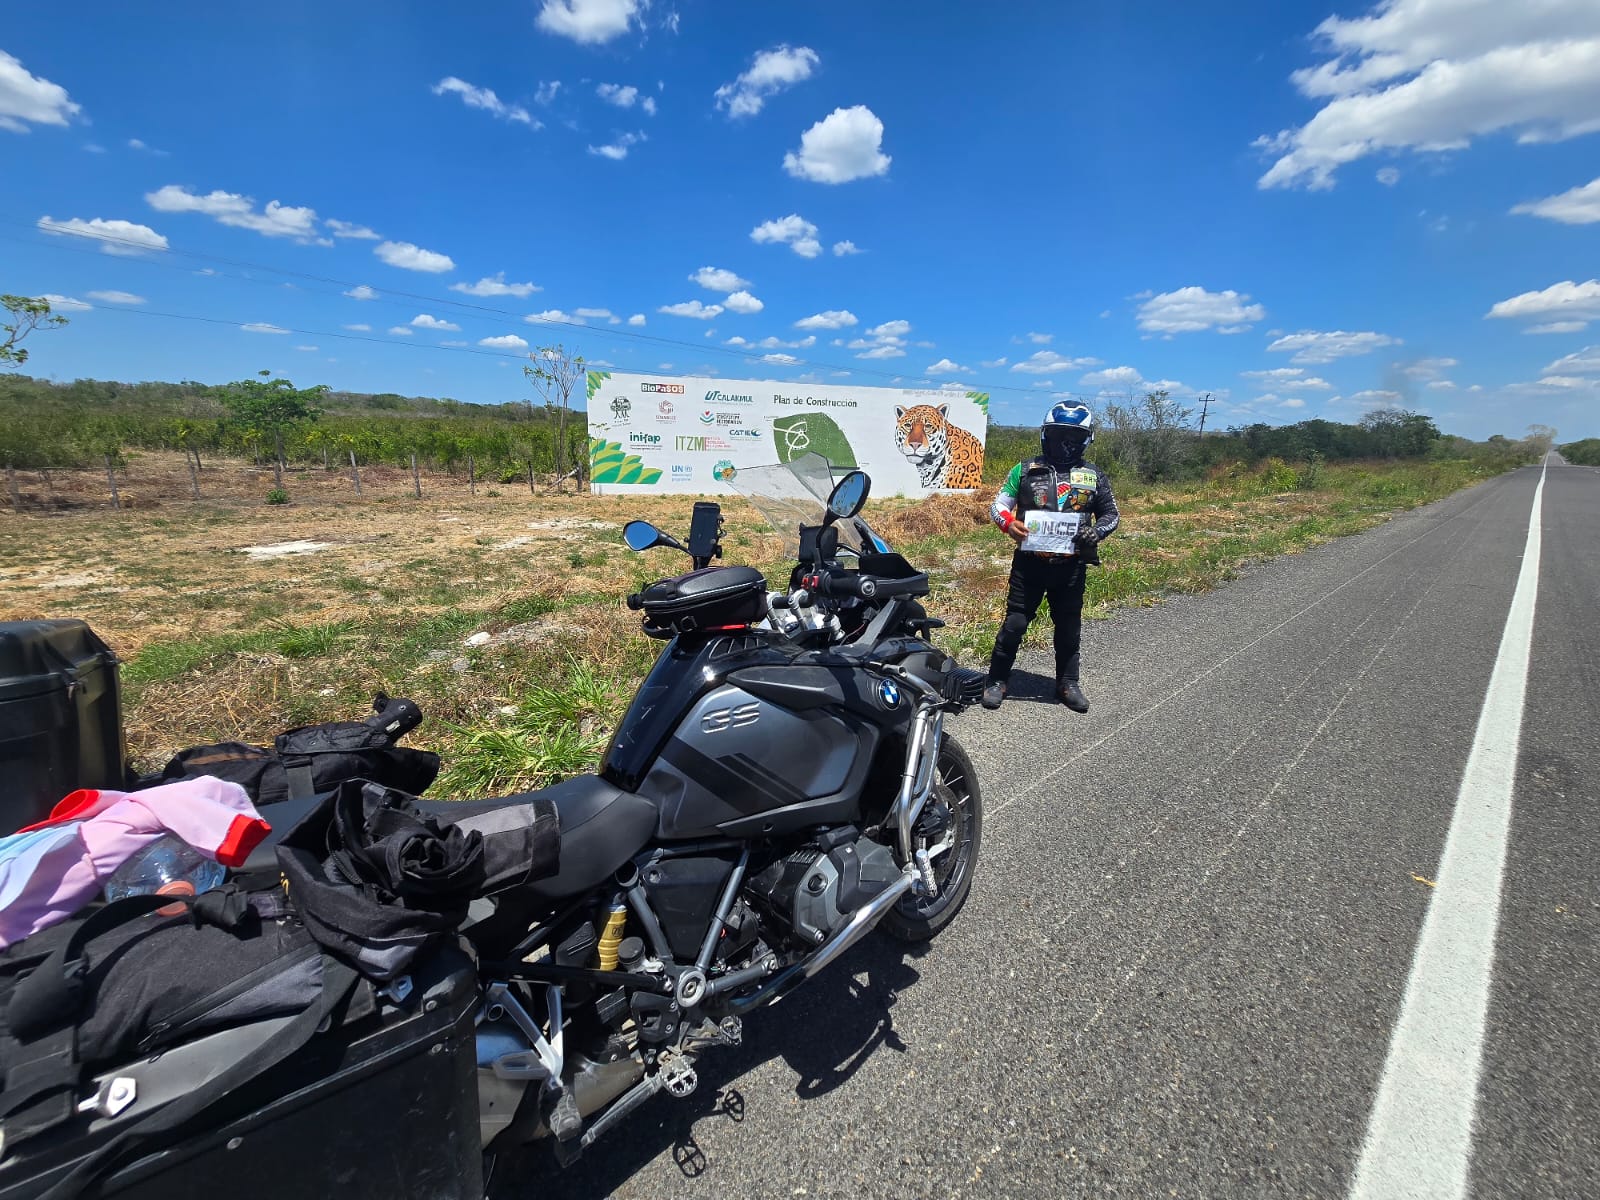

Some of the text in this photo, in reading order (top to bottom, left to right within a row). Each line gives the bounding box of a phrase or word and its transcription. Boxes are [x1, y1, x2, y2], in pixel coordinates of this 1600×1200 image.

[773, 394, 791, 405] Plan
[793, 396, 804, 405] de
[629, 431, 661, 444] inifap
[671, 464, 684, 473] UN
[700, 701, 760, 734] GS
